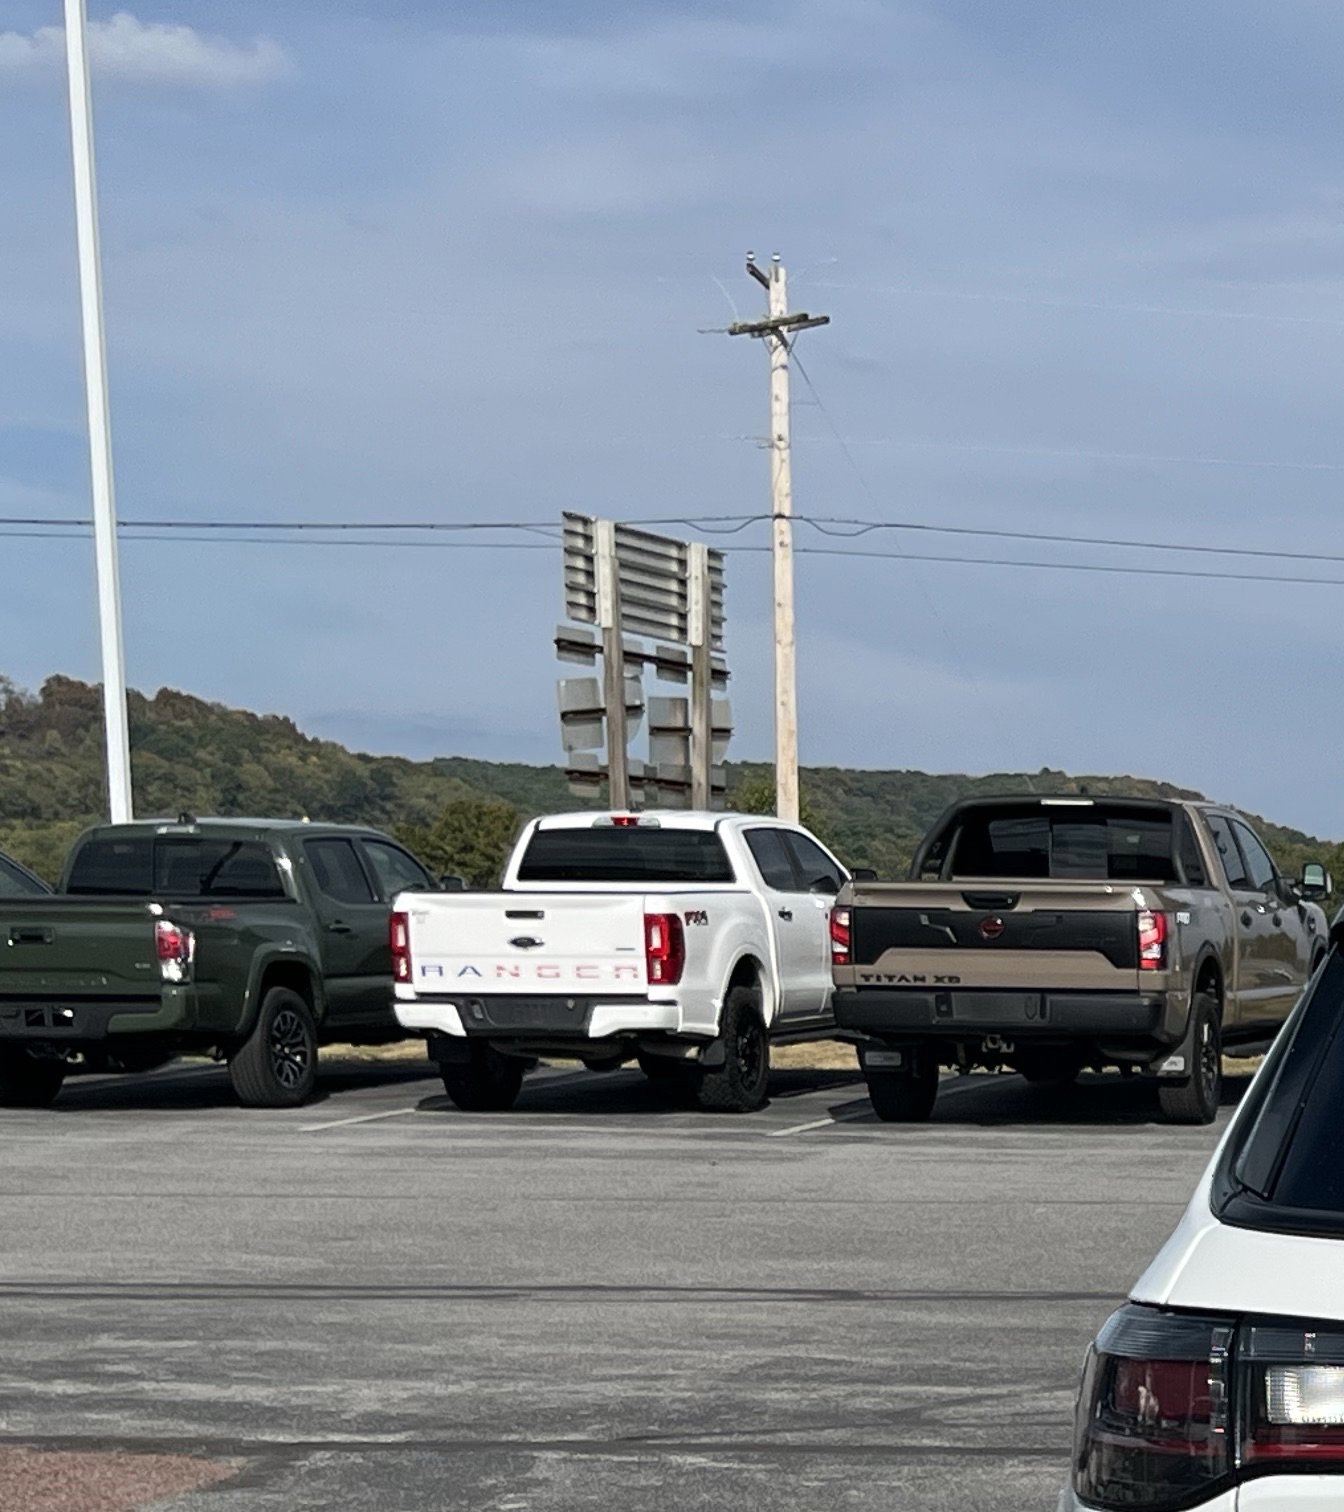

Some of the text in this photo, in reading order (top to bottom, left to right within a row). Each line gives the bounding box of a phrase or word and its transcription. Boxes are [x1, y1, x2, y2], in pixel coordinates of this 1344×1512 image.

[420, 965, 639, 979] RANGER
[860, 974, 961, 984] TITAN XD
